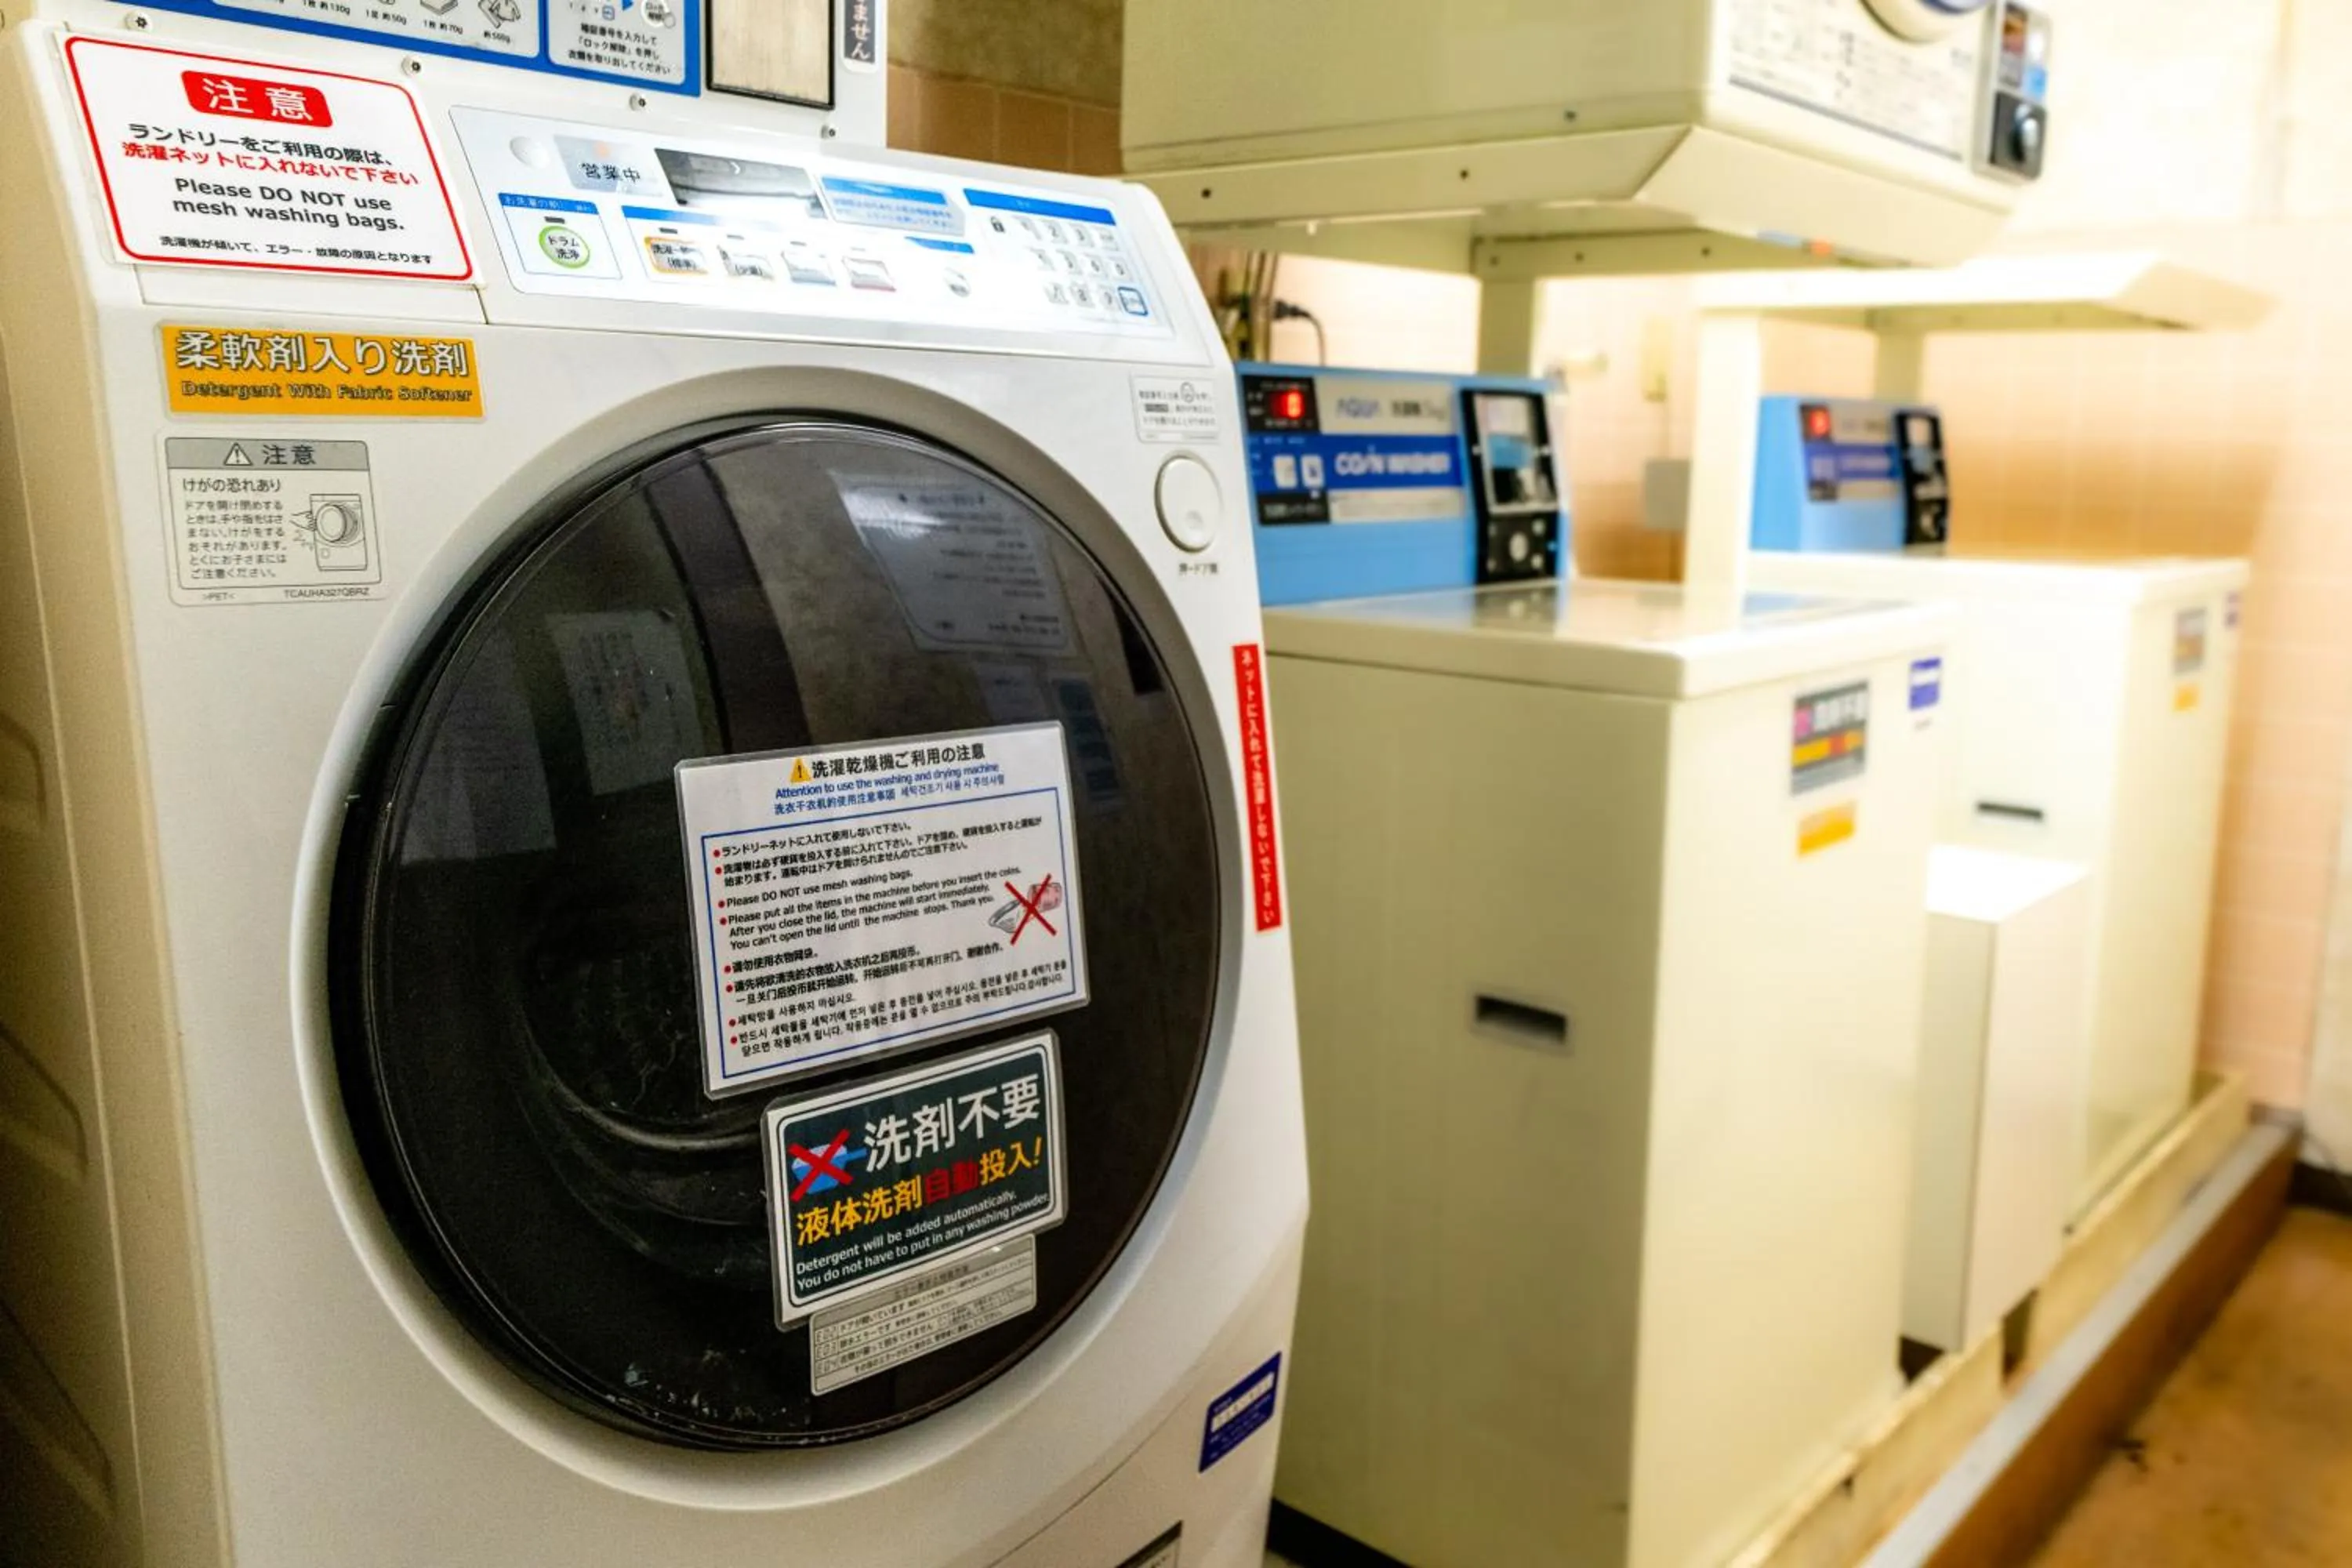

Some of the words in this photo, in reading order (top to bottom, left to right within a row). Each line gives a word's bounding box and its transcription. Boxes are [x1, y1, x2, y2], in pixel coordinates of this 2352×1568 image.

[201, 78, 314, 122] 注意
[122, 141, 419, 187] 洗濯ネットに入れないで下さい
[128, 122, 393, 167] ランドリーをご利用の際は、
[581, 162, 641, 183] 営業中
[173, 195, 238, 219] mesh
[246, 201, 340, 229] washing
[347, 211, 405, 233] bags.
[175, 178, 252, 200] Please
[260, 183, 294, 203] DO
[301, 189, 345, 207] NOT
[354, 195, 393, 212] use
[176, 331, 469, 376] 柔軟剤入り洗剤
[182, 381, 281, 401] Detergent
[288, 383, 332, 399] With
[337, 385, 393, 401] Fabric
[397, 385, 474, 402] Softener
[263, 444, 317, 465] 注意
[182, 477, 281, 492] けがの恐れあり
[811, 742, 985, 778] 洗濯乾燥機ご利用の注意
[775, 784, 822, 800] Attention
[824, 782, 834, 793] to
[837, 781, 854, 791] use
[855, 777, 871, 789] the
[874, 772, 912, 788] washing
[914, 771, 931, 781] and
[726, 894, 759, 907] Please
[761, 891, 776, 901] DO
[780, 887, 800, 898] NOT
[803, 885, 819, 894] use
[822, 879, 848, 891] mesh
[849, 873, 887, 888] washing
[890, 868, 913, 881] bags.
[728, 910, 760, 924] Please
[763, 907, 780, 920] put
[782, 905, 794, 915] all
[797, 902, 813, 913] the
[815, 897, 841, 909] items
[844, 895, 852, 904] in
[855, 891, 869, 902] the
[873, 885, 909, 899] machine
[912, 880, 938, 892] before
[941, 879, 956, 889] you
[729, 924, 755, 938] After
[757, 923, 775, 934] you
[779, 916, 803, 928] close
[806, 913, 822, 924] the
[823, 909, 838, 922] lid,
[841, 906, 855, 917] the
[858, 899, 896, 914] machine
[898, 896, 914, 906] will
[731, 938, 749, 949] You
[752, 933, 776, 946] can't
[779, 930, 803, 942] open
[806, 925, 822, 935] the
[823, 922, 836, 932] lid
[838, 918, 859, 930] until
[864, 914, 879, 925] the
[881, 907, 919, 921] machine
[863, 1073, 1040, 1173] 洗剤不要
[797, 1243, 859, 1276] Detergent
[862, 1234, 883, 1252] will
[887, 1228, 902, 1244] be
[905, 1216, 940, 1238] added
[942, 1189, 1016, 1224] automatically.
[797, 1273, 820, 1291] You
[823, 1266, 840, 1282] do
[842, 1260, 861, 1276] not
[864, 1247, 893, 1269] have
[896, 1243, 909, 1257] to
[910, 1236, 929, 1254] put
[932, 1231, 942, 1244] in
[945, 1225, 963, 1242] any
[965, 1207, 1009, 1232] washing
[1010, 1192, 1048, 1216] powder.
